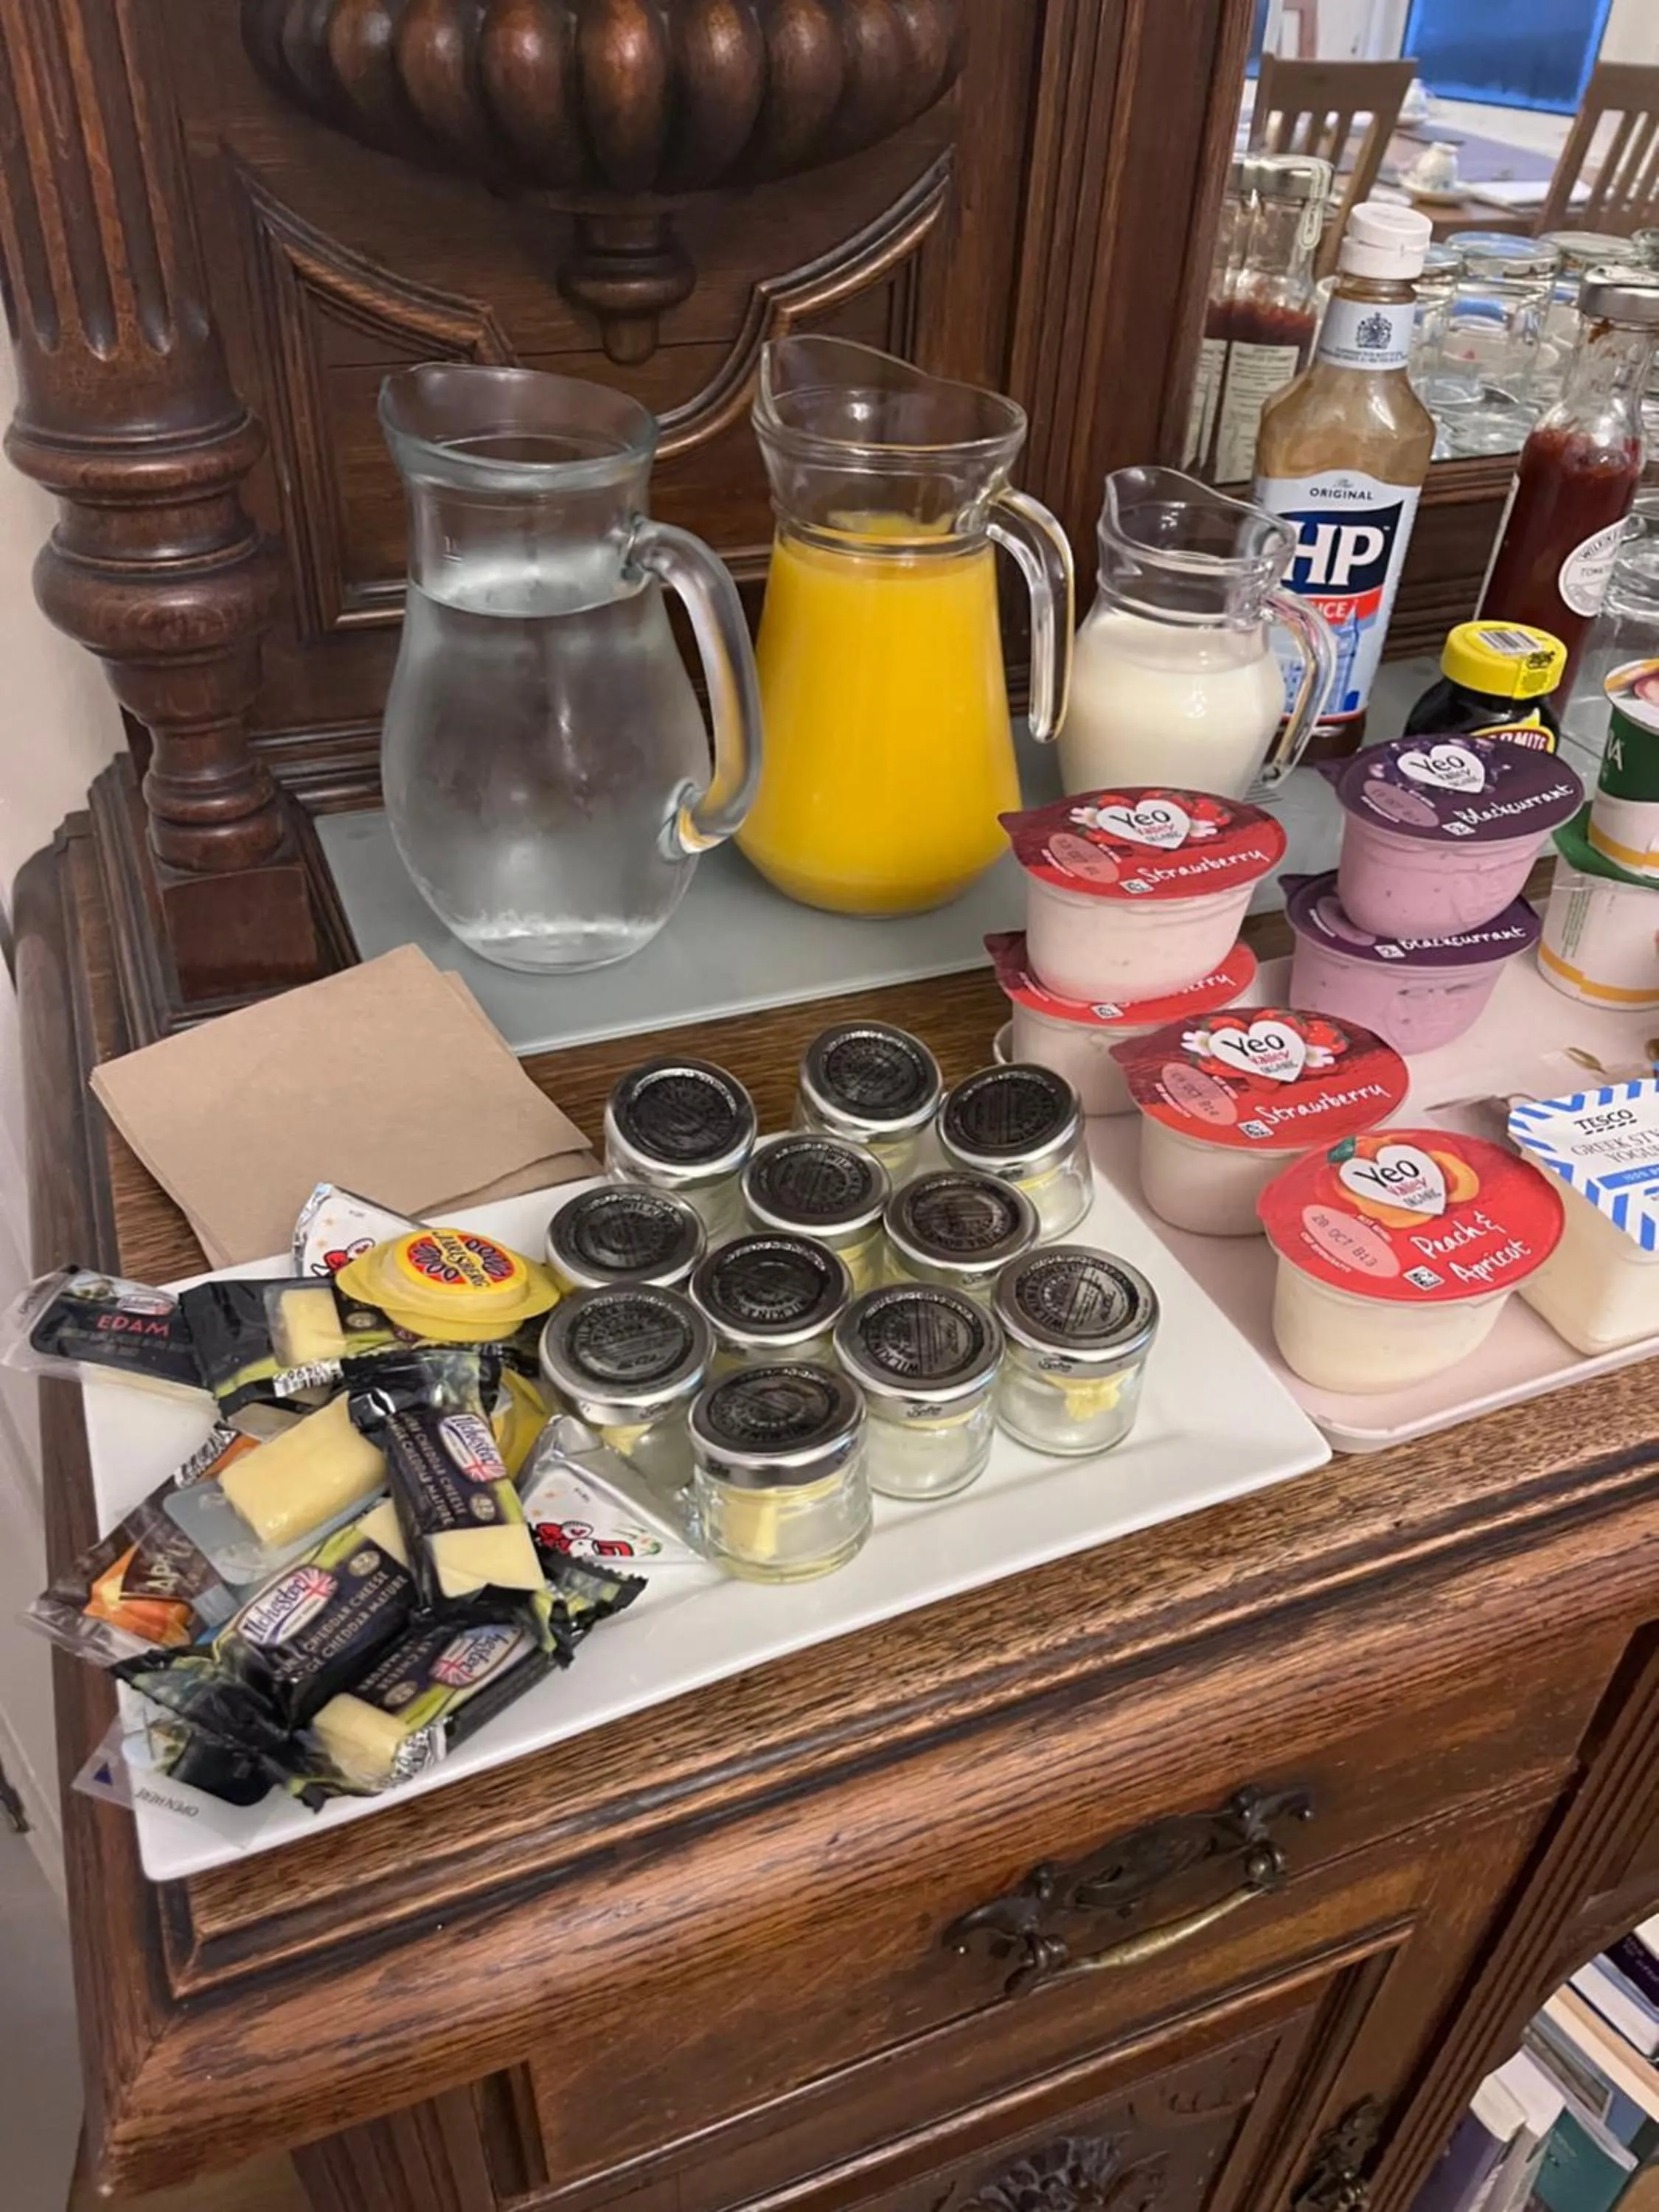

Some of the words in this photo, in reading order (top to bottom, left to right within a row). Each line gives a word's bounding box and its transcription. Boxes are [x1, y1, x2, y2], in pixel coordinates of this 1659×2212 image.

[1310, 487, 1374, 500] ORIGINAL
[1281, 520, 1385, 585] HP
[1409, 755, 1465, 774] Yeo
[1108, 810, 1171, 830] Yeo
[1452, 783, 1575, 825] Blackcurrant
[1137, 849, 1271, 884] Strawberry
[1220, 1034, 1286, 1057] Yeo
[1254, 1084, 1392, 1125] Strawberry
[1573, 1108, 1634, 1131] TESCO
[1571, 1135, 1632, 1156] GREEK
[1352, 1159, 1420, 1189] Yeo
[1327, 1228, 1352, 1248] OCT
[1410, 1218, 1481, 1260] Peach
[1448, 1237, 1532, 1284] Apricot
[97, 1315, 170, 1338] EDAM
[425, 1484, 456, 1526] MATURE
[440, 1476, 468, 1515] CHEESE
[241, 1576, 308, 1643] Ilchester
[302, 1605, 352, 1652] CHEDDAR
[349, 1570, 390, 1608] CHEESE
[321, 1610, 371, 1660] CHEDDAR
[369, 1573, 410, 1613] MATURE
[459, 1633, 509, 1674] hester
